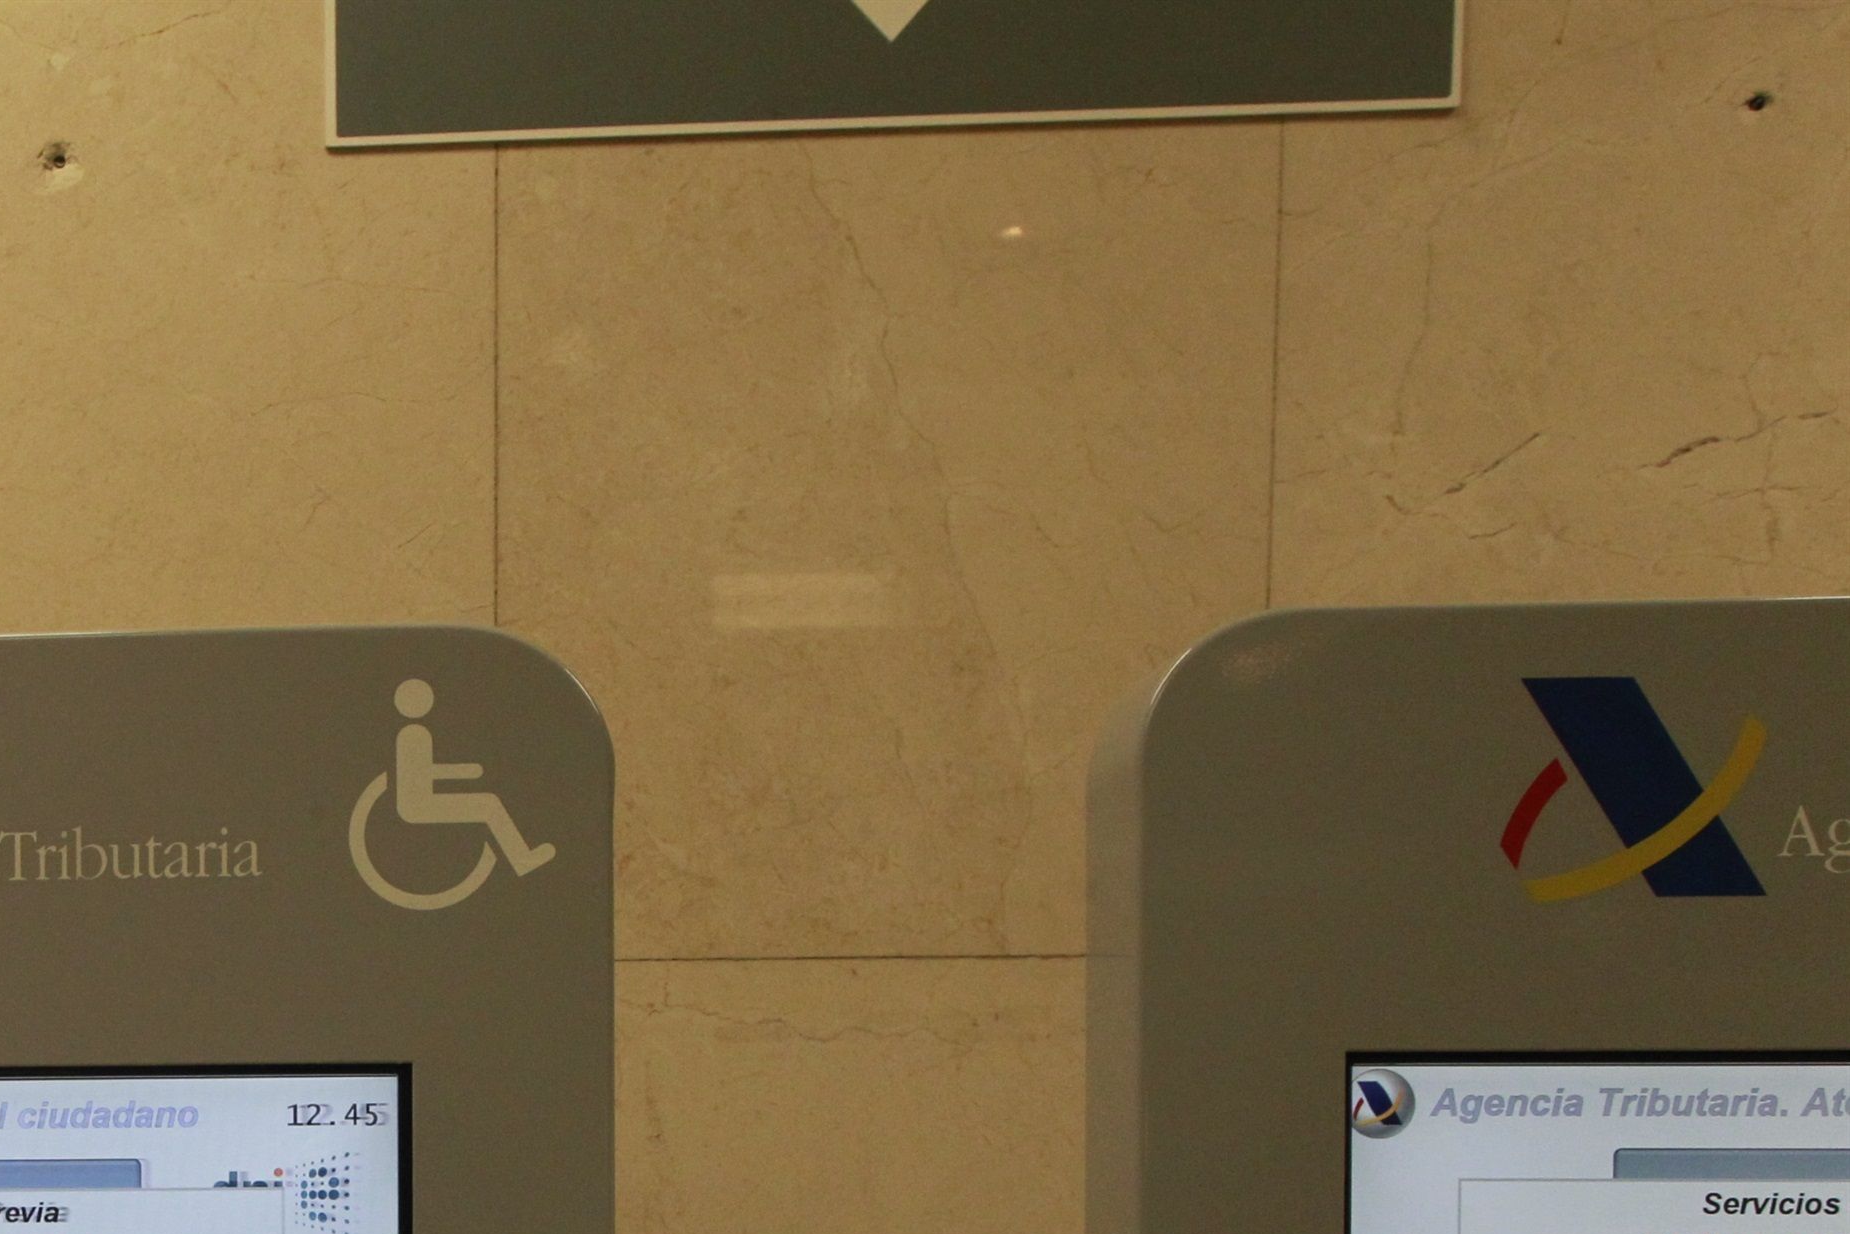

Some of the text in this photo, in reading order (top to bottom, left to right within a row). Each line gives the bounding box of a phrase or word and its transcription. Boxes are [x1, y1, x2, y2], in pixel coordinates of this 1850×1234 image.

[17, 1100, 198, 1129] ciudadano
[287, 1102, 379, 1126] 12.45
[1430, 1088, 1584, 1123] Agencia
[1599, 1087, 1787, 1117] Tributaria.
[1703, 1193, 1840, 1215] Servicios
